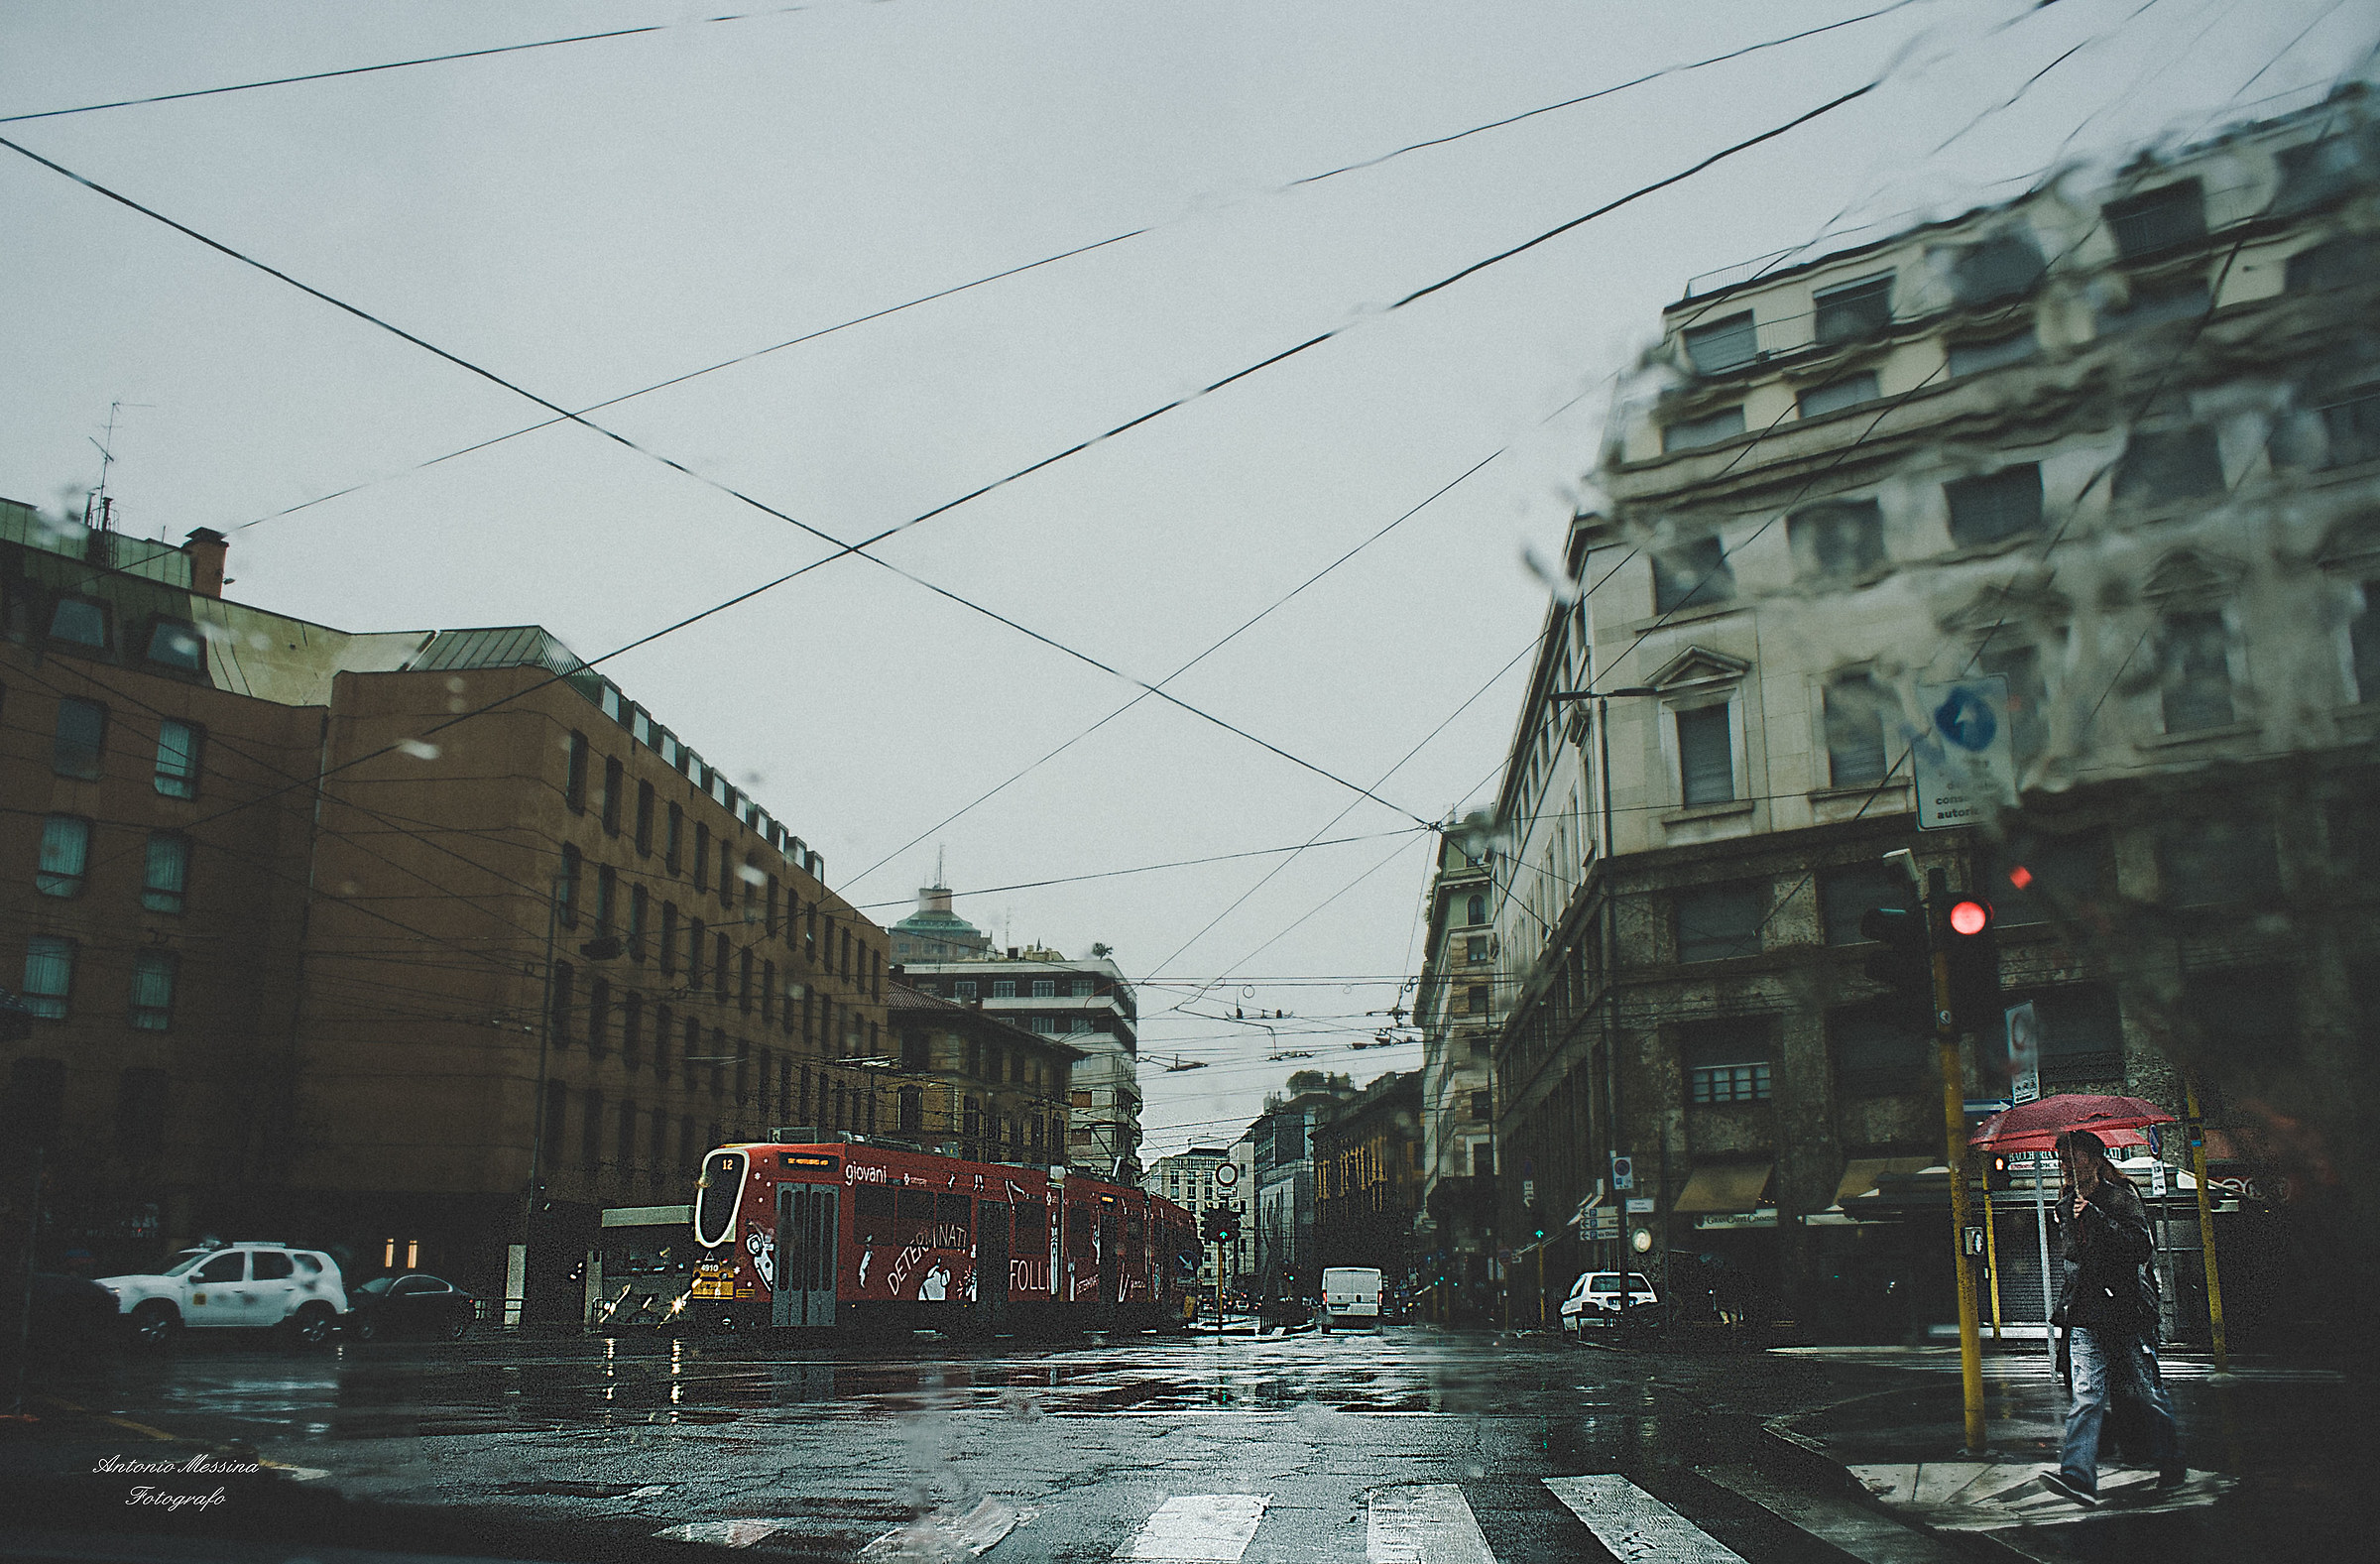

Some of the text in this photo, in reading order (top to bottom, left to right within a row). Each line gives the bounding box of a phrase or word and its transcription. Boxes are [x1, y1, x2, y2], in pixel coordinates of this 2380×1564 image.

[722, 1158, 734, 1170] 12
[845, 1160, 888, 1187] giovani
[887, 1224, 968, 1296] DETERMINATI
[1010, 1260, 1050, 1291] FOLLI
